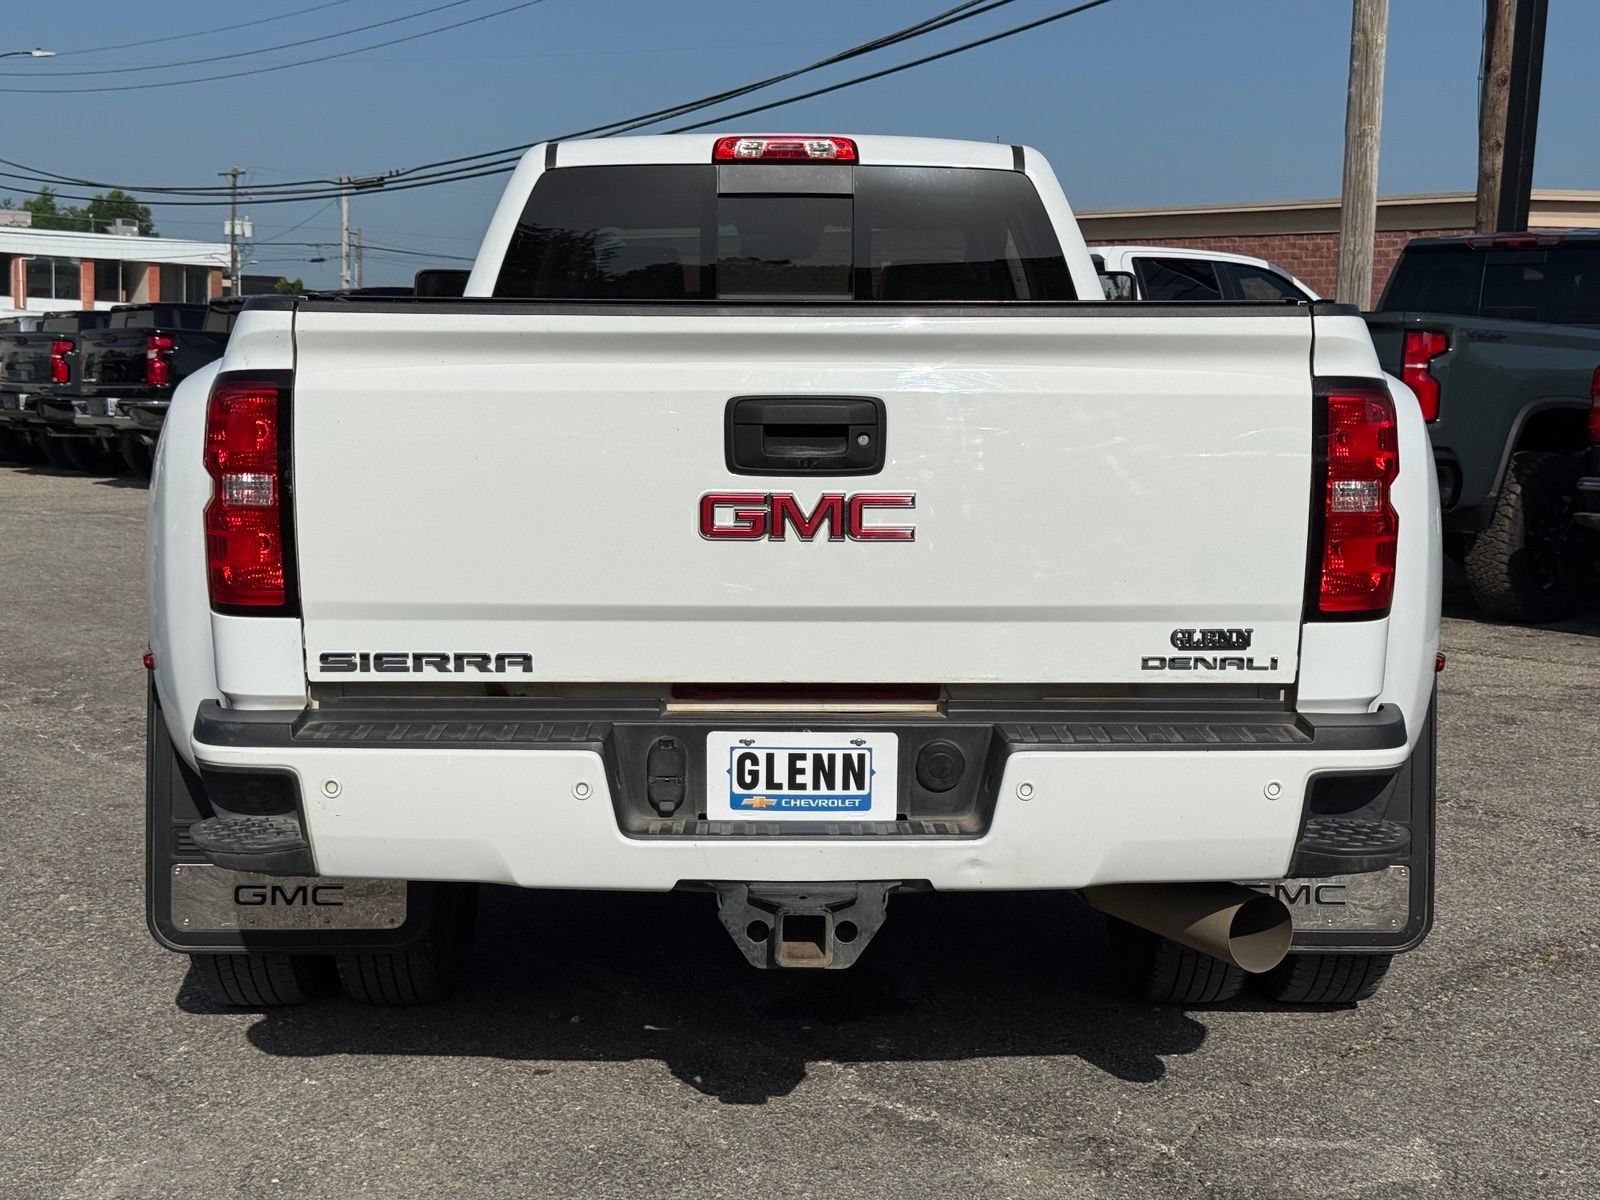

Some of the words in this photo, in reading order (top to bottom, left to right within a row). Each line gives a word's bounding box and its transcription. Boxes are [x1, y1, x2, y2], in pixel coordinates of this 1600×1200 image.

[698, 490, 916, 542] GMC
[1170, 628, 1253, 650] GLENN
[319, 652, 533, 673] SIERRA
[1141, 656, 1278, 670] DENALI
[736, 751, 866, 791] GLENN
[782, 799, 862, 807] CHEVROLET
[234, 885, 344, 906] GMC
